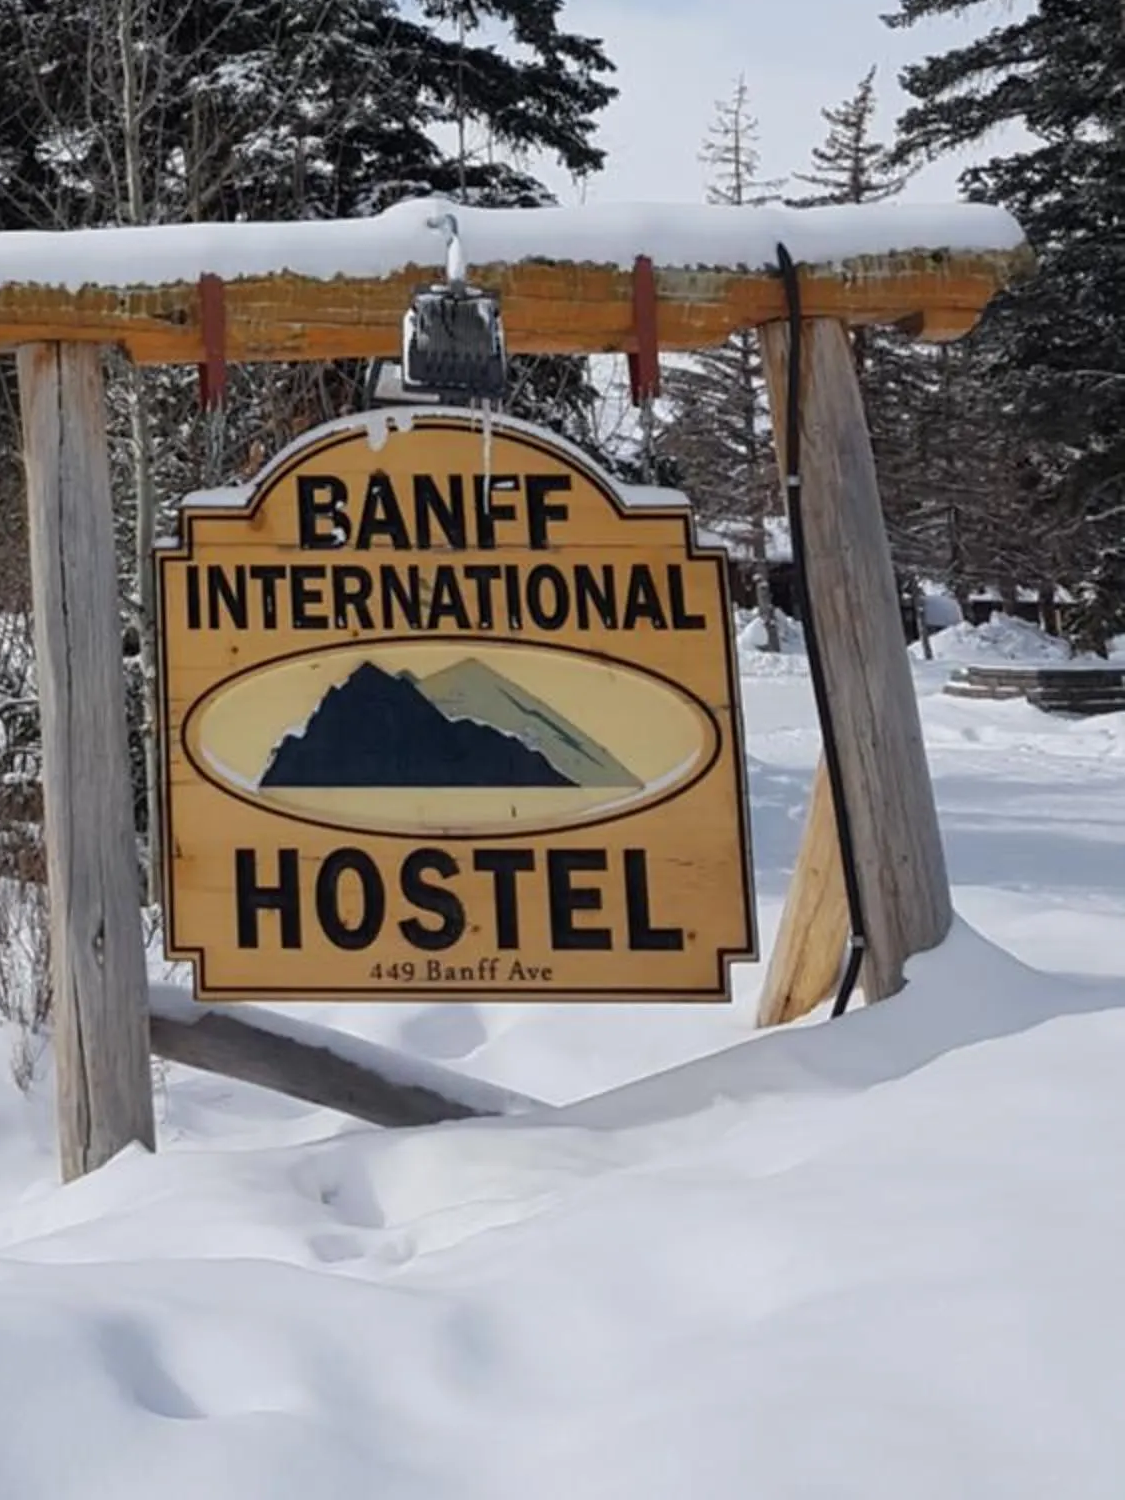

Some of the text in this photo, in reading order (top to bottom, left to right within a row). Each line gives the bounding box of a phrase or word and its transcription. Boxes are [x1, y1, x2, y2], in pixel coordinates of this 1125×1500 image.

[296, 470, 572, 551] BANFF
[186, 564, 707, 630] INTERNATIONAL
[235, 847, 684, 951] HOSTEL
[369, 957, 554, 982] 449 Banff Ave
